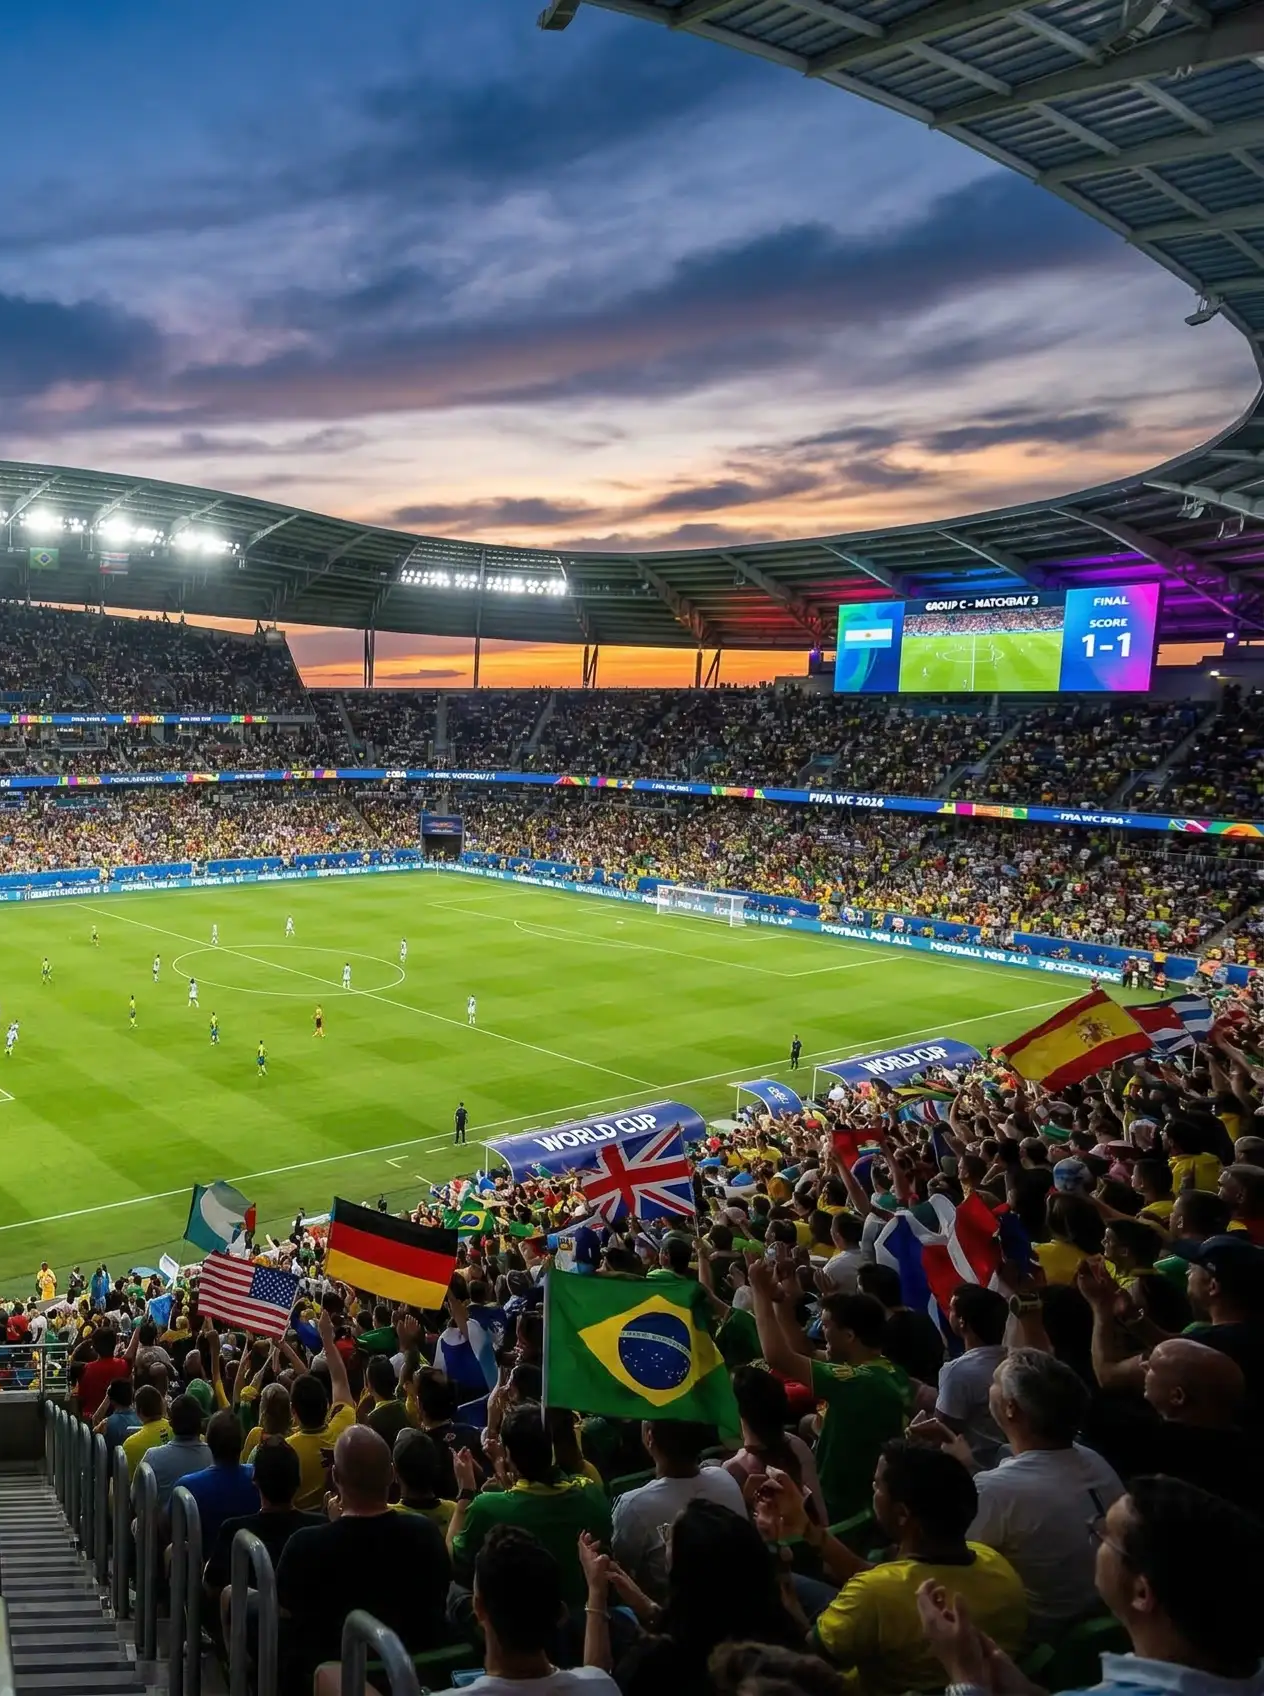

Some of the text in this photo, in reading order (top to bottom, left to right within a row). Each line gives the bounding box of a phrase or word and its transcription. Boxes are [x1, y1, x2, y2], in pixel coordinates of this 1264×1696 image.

[959, 600, 967, 609] C
[1031, 595, 1039, 605] 3
[1093, 596, 1130, 606] FINAL
[1089, 618, 1128, 628] SCORE
[1081, 632, 1132, 658] 1-1
[836, 795, 854, 805] WC
[533, 1113, 657, 1152] WORLD CUP
